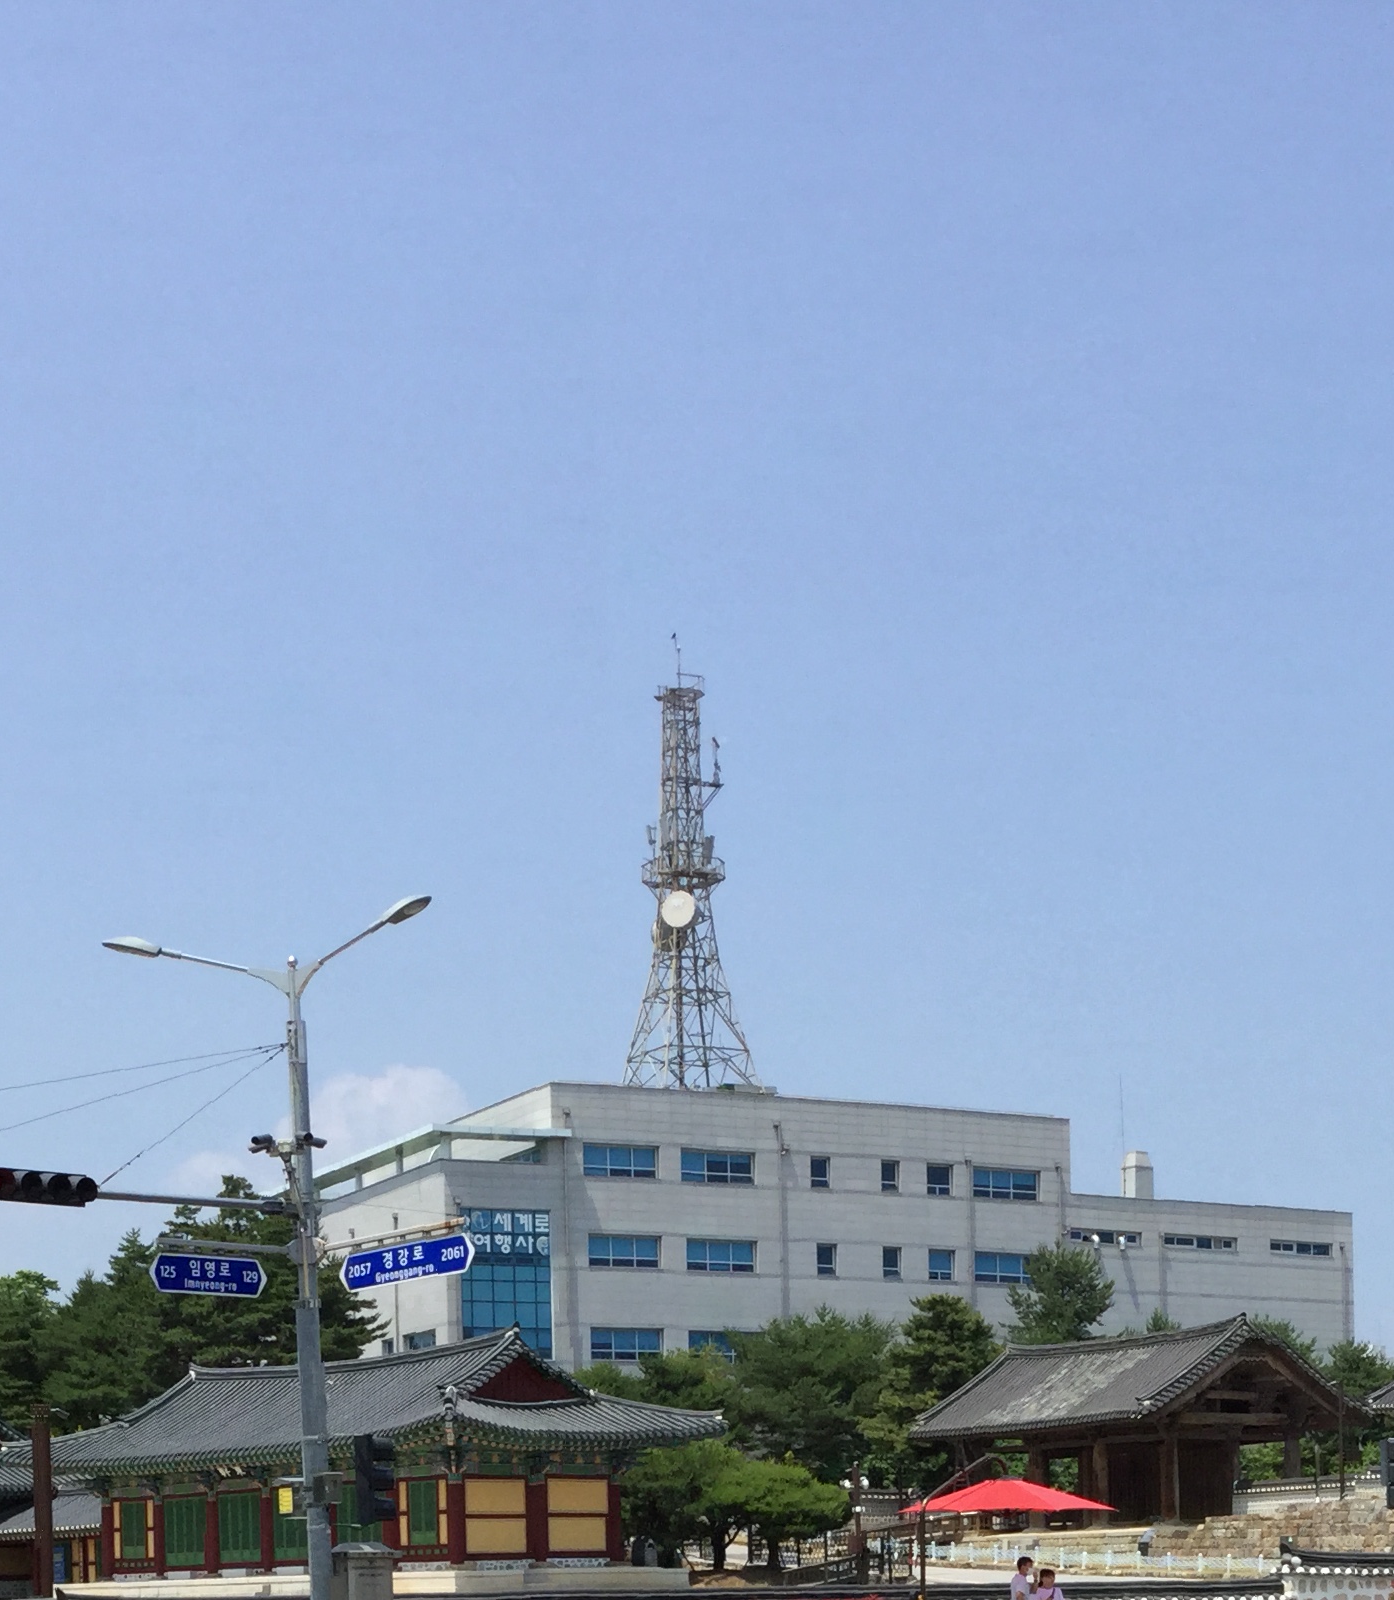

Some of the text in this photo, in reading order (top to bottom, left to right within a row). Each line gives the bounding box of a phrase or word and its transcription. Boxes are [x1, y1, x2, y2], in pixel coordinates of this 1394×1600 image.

[494, 1213, 549, 1232] 세계로
[473, 1234, 534, 1254] 여행사
[382, 1246, 424, 1269] 경강로
[441, 1246, 465, 1261] 2061
[160, 1265, 176, 1278] 125
[189, 1260, 231, 1278] 임영로
[243, 1271, 258, 1283] 129
[348, 1263, 371, 1278] 2057
[375, 1264, 434, 1283] Gyeonggang-ro
[185, 1278, 237, 1292] Imnyeong-ro
